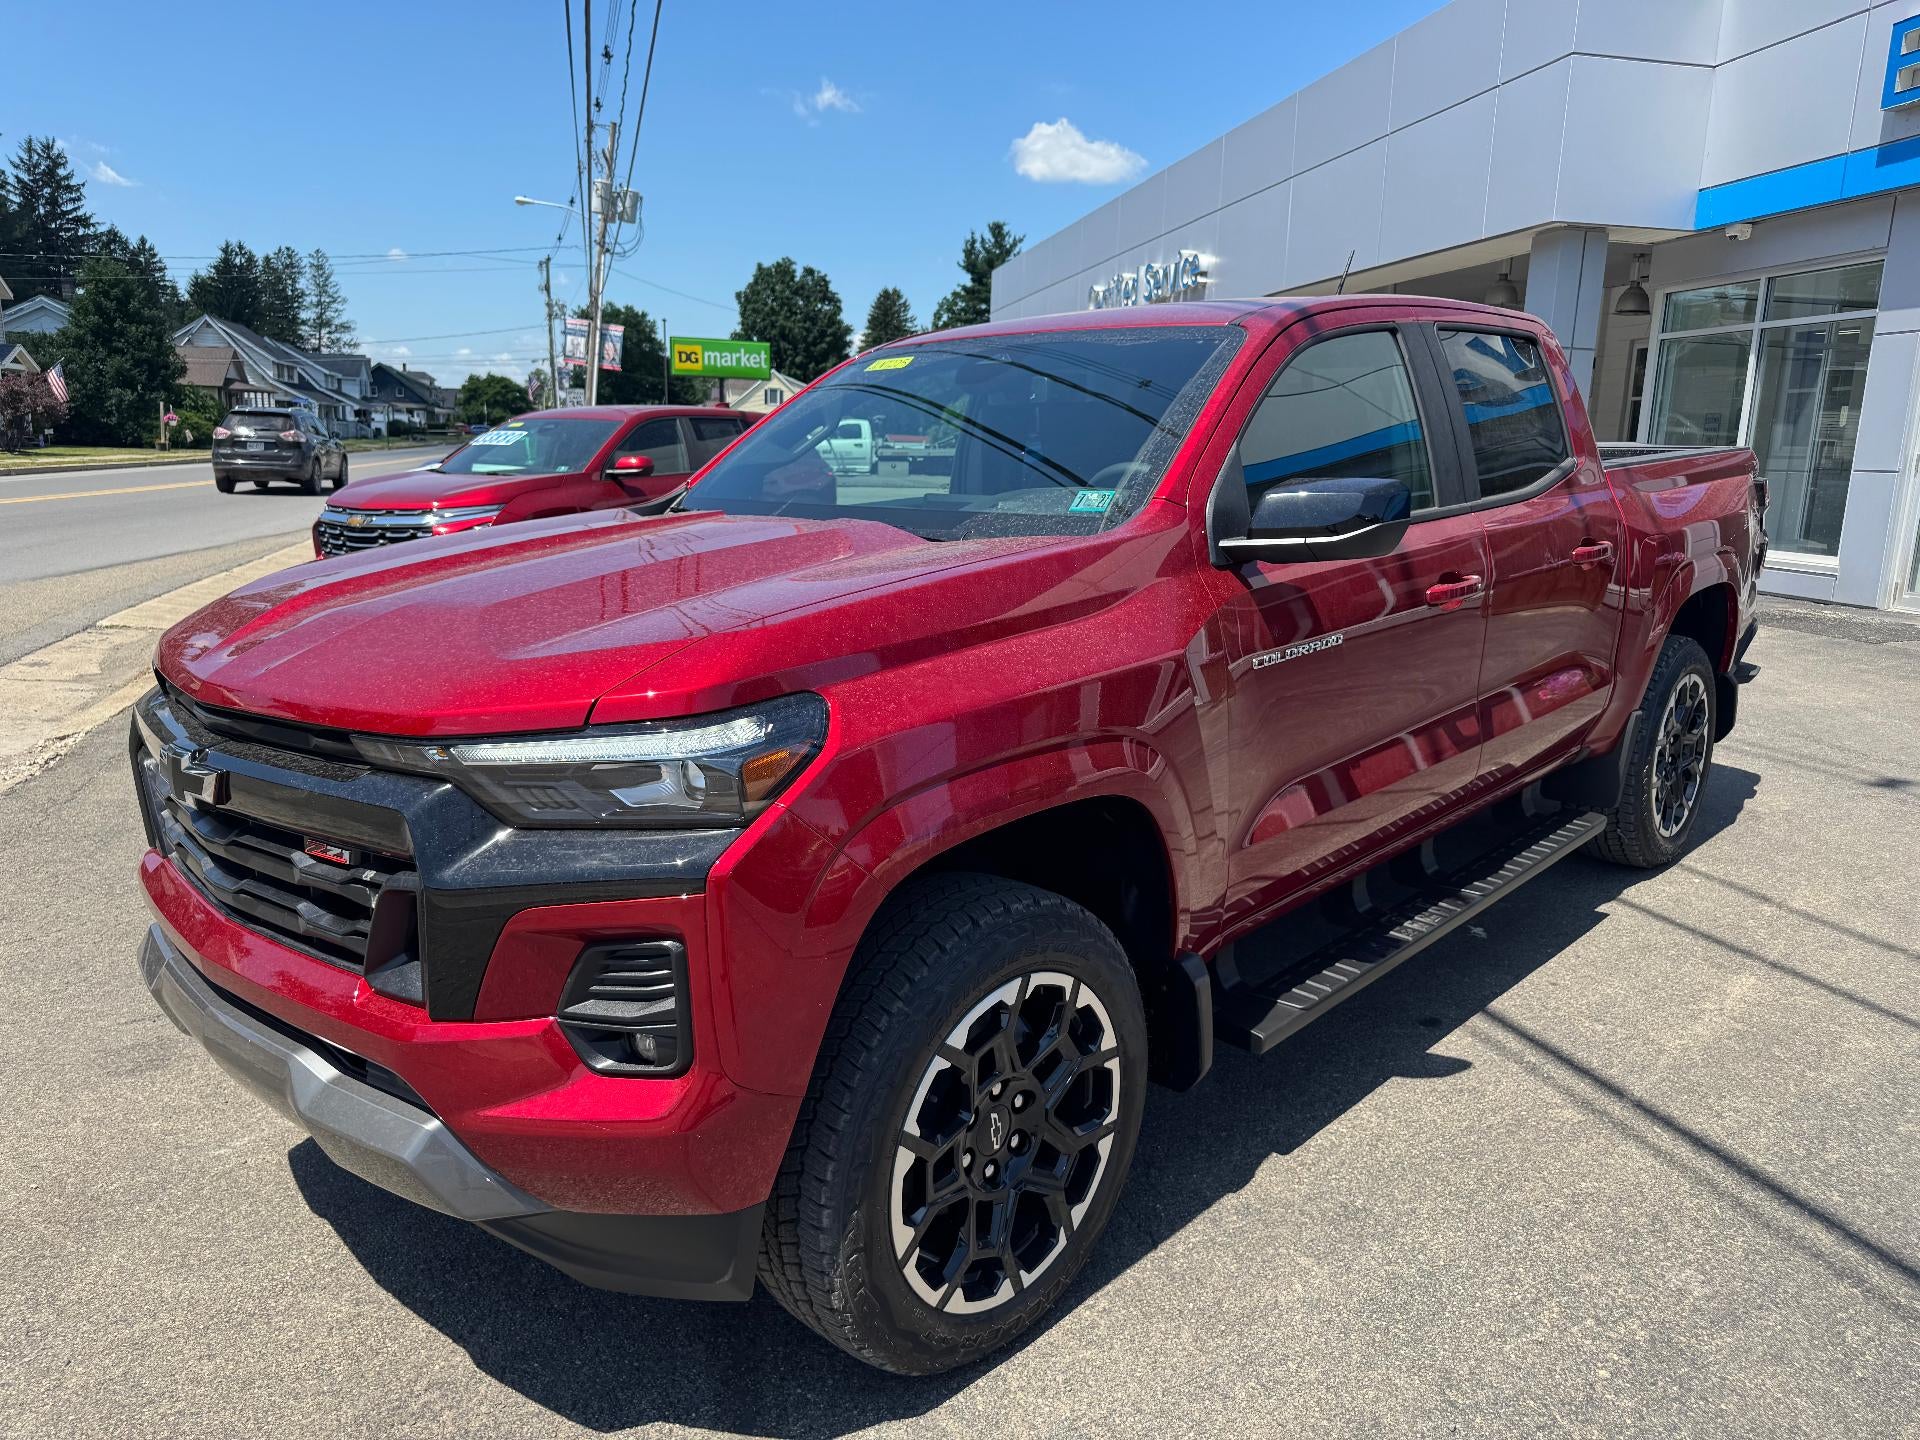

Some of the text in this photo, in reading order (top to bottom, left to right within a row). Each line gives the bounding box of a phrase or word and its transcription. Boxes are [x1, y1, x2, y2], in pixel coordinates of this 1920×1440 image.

[1143, 250, 1202, 302] Service
[677, 349, 768, 369] DG market
[1252, 633, 1344, 670] COLORADO
[304, 839, 350, 865] Z71
